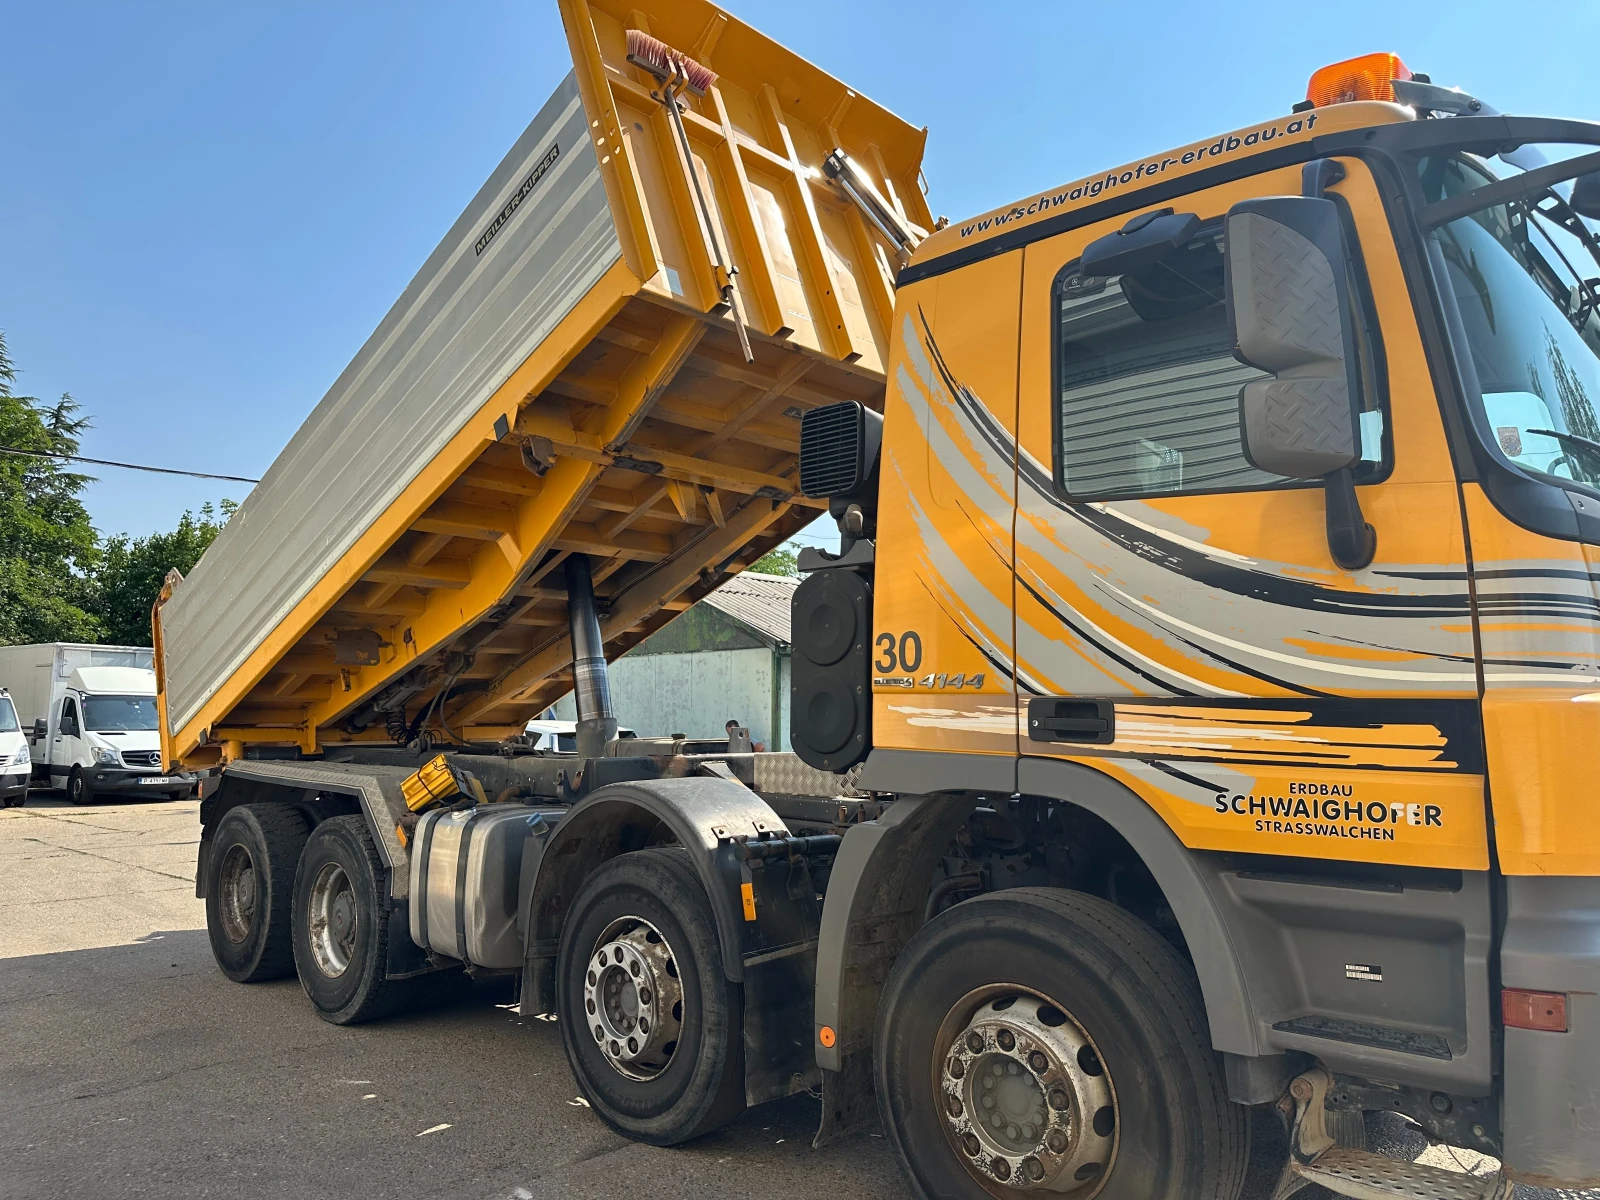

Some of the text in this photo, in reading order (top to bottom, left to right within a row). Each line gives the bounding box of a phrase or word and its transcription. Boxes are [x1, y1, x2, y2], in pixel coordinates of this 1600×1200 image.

[959, 113, 1319, 239] www.schwaighofer-erdbau.at
[476, 146, 559, 254] MEILLER-KIPPER
[874, 630, 923, 674] 30
[918, 672, 986, 689] 4144
[1288, 782, 1353, 797] ERDBAU
[1214, 793, 1443, 827] SCHWAIGHOFER
[1254, 819, 1395, 842] STRASSWALCHEN
